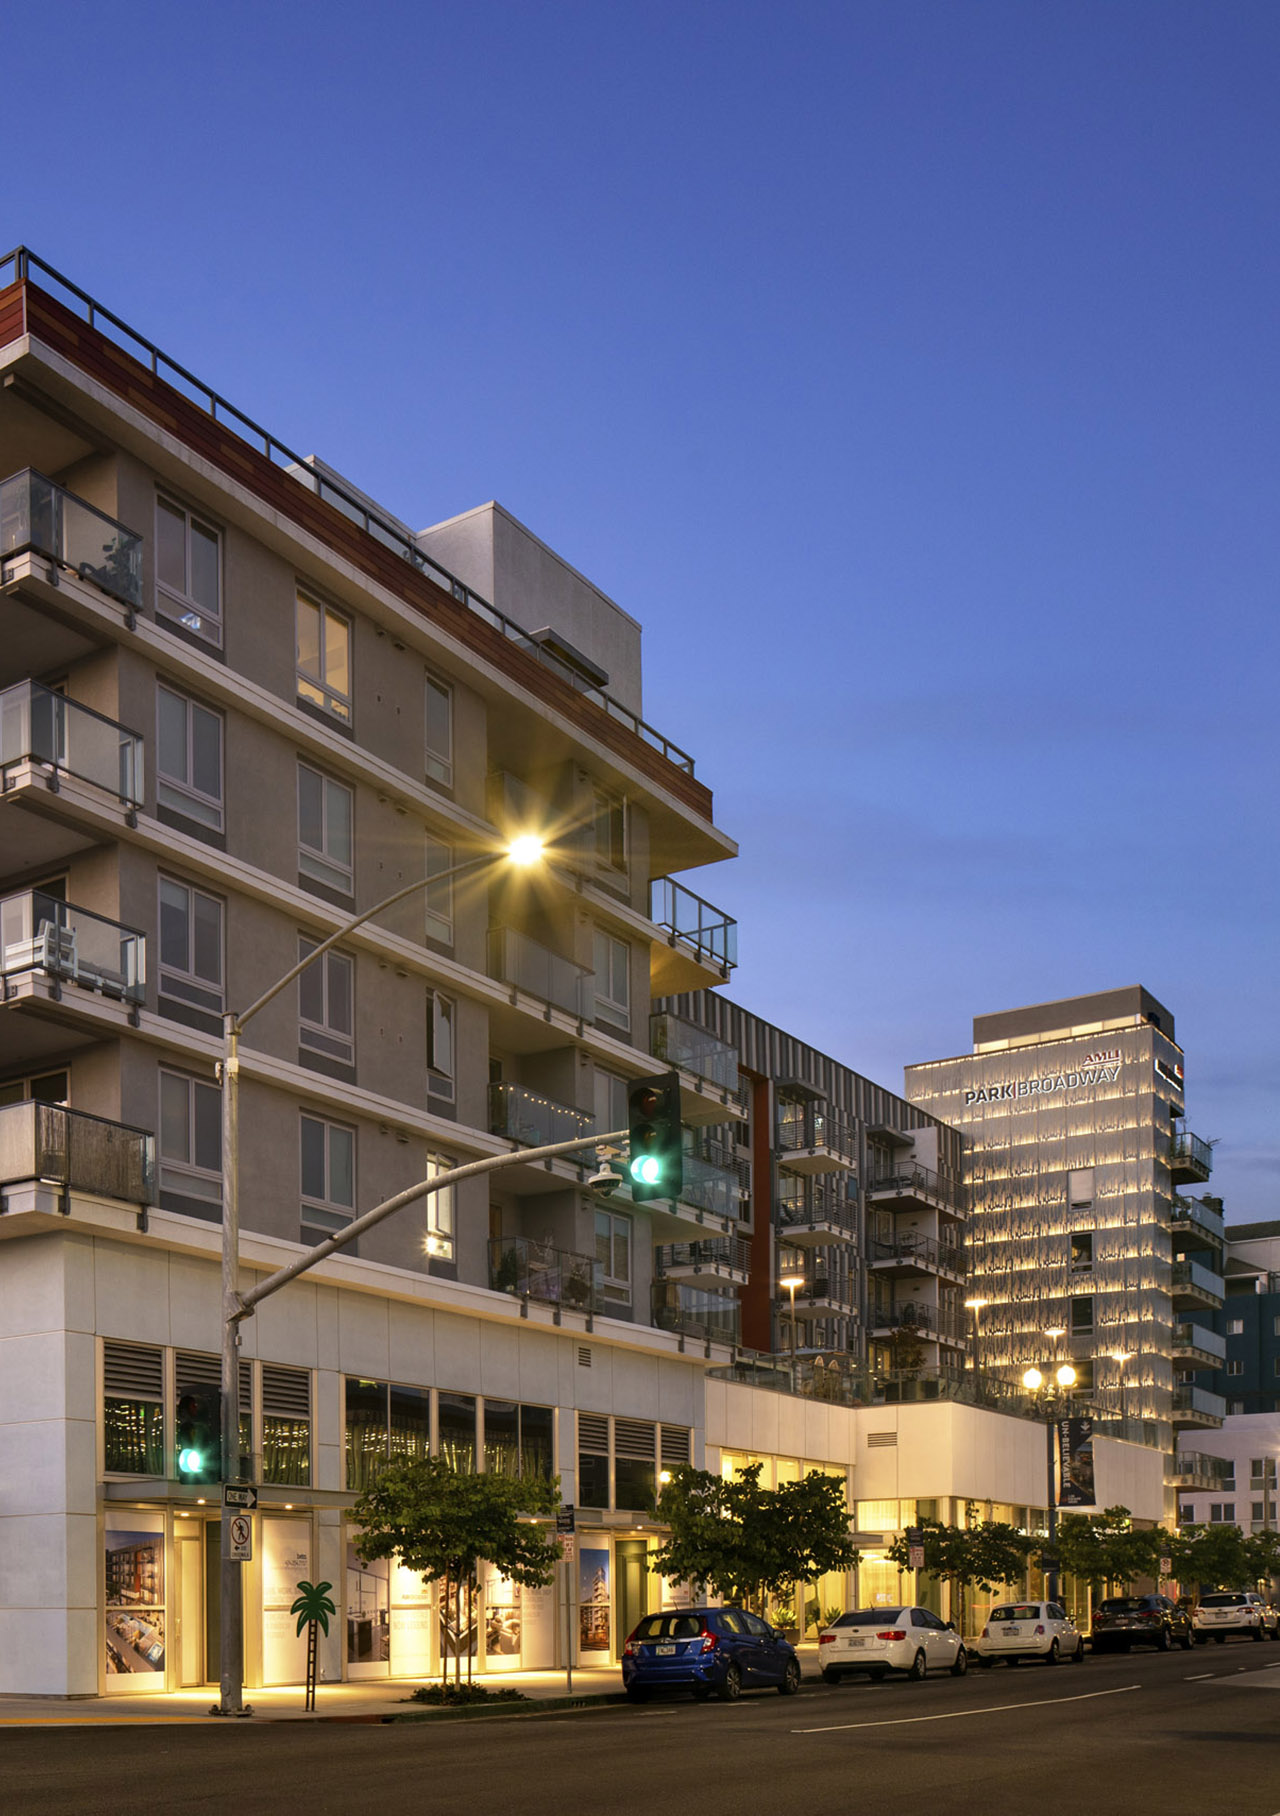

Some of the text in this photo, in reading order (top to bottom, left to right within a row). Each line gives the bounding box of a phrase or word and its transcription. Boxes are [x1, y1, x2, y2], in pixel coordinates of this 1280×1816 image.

[1083, 1049, 1121, 1066] AMLI
[965, 1066, 1121, 1106] PARK BROADWAY
